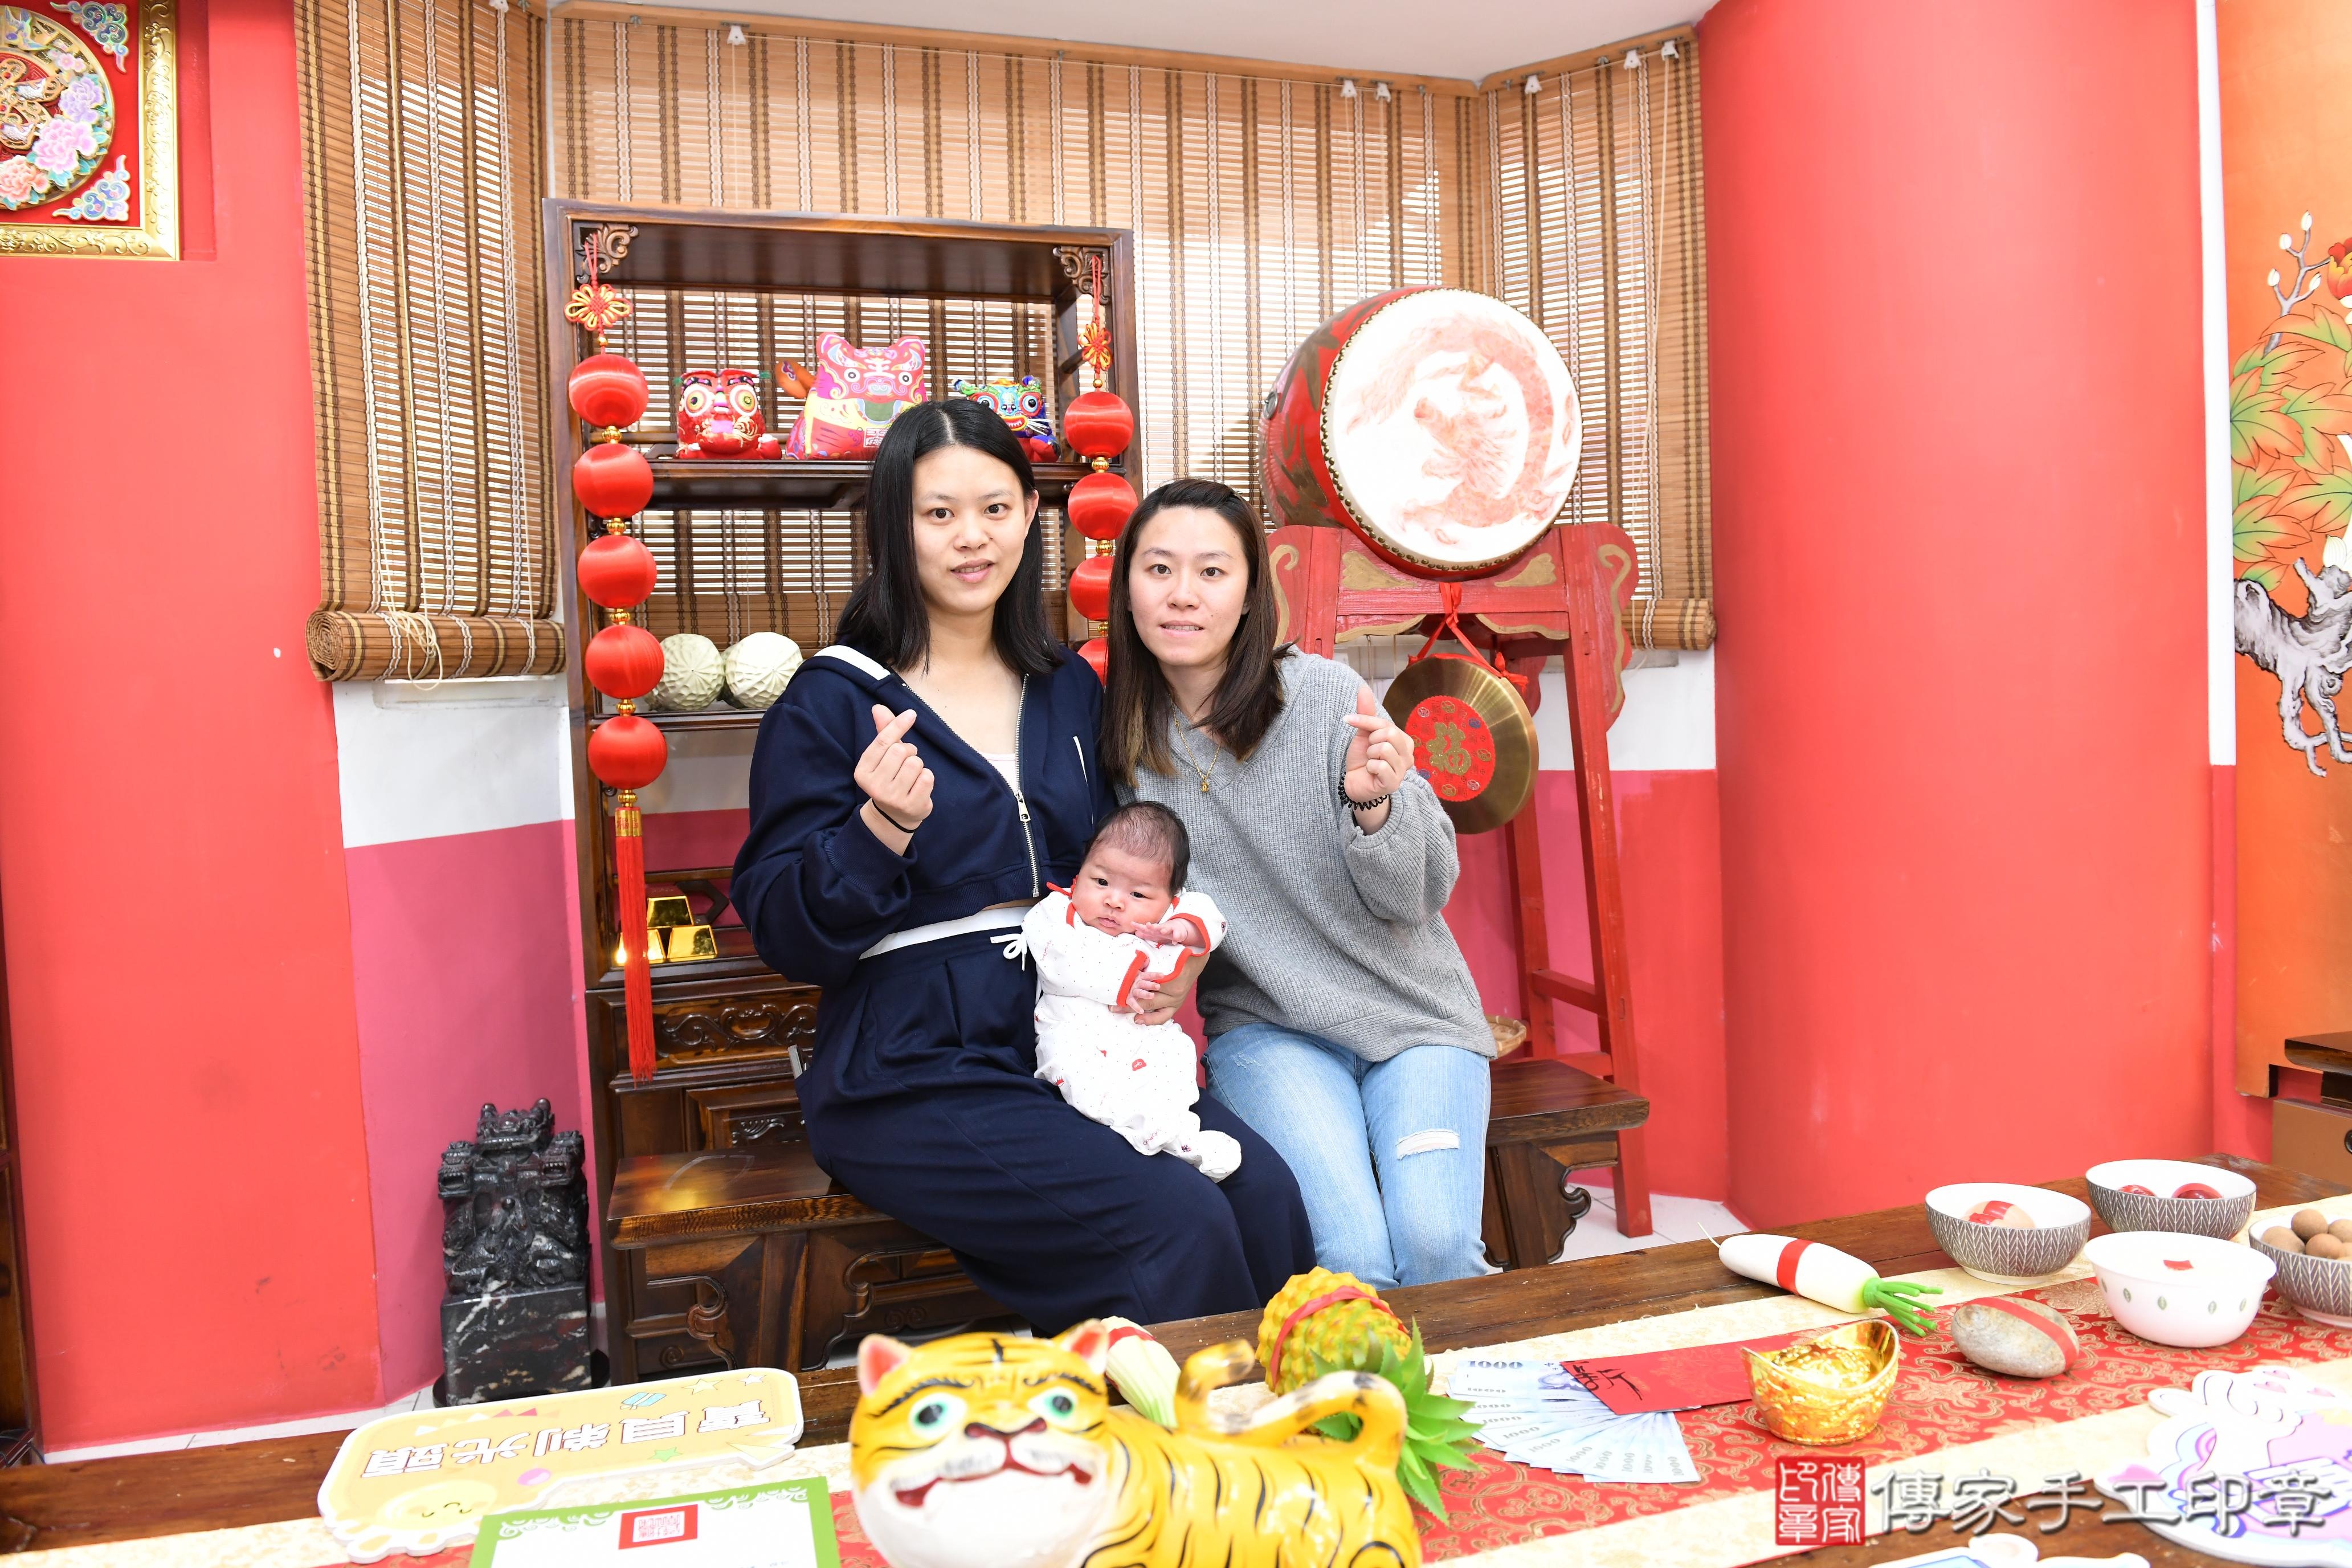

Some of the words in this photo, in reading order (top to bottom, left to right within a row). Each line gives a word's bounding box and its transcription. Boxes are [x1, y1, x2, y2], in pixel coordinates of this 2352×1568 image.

[1426, 722, 1471, 775] 福
[360, 1399, 771, 1478] 寶貝剃光頭
[1502, 1427, 1540, 1439] 1000
[1528, 1439, 1561, 1453] 1000
[1566, 1446, 1592, 1463] 1000
[1594, 1451, 1612, 1470] 1000
[1622, 1452, 1635, 1472] 1000
[1667, 1456, 1684, 1476] 1000
